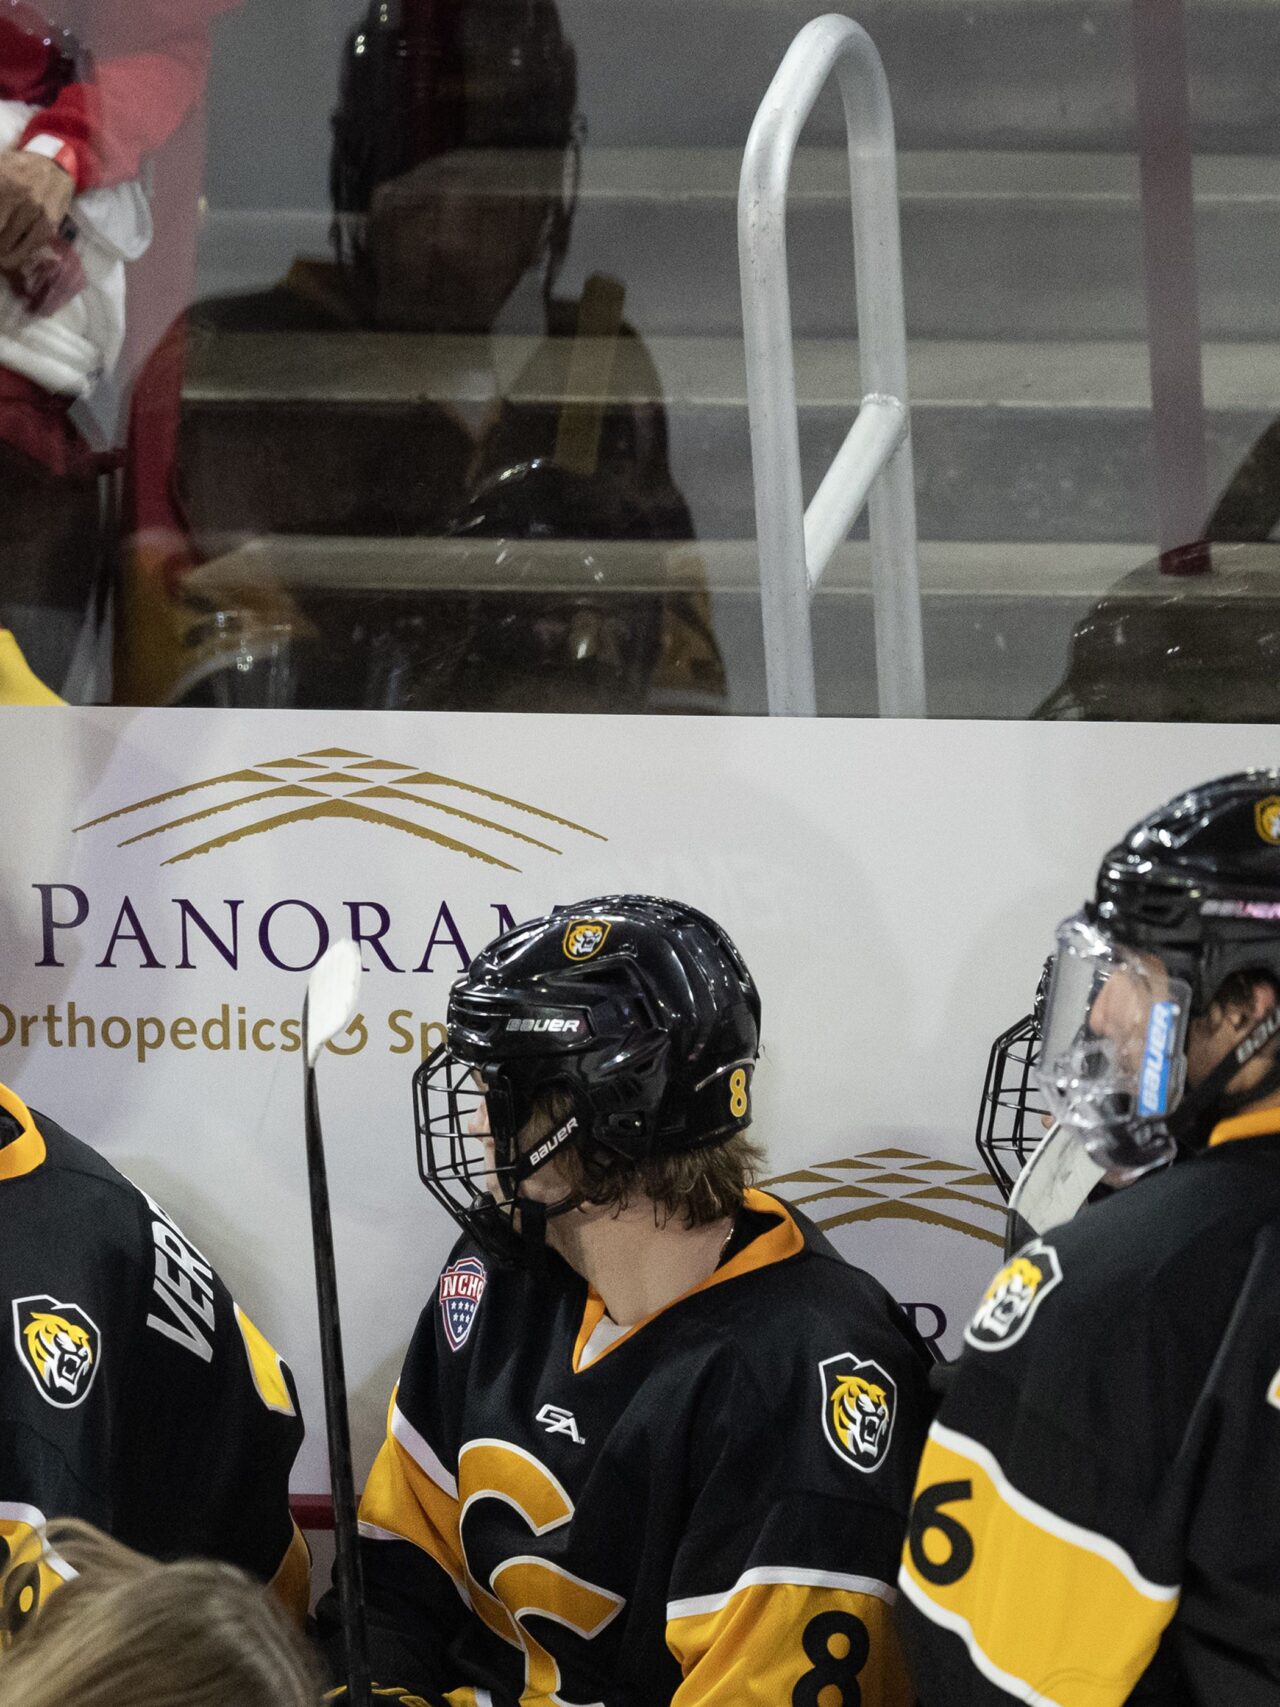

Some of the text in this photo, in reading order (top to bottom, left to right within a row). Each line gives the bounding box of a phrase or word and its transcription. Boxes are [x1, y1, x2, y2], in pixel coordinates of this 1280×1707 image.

[506, 1018, 581, 1033] BAUER
[729, 1068, 747, 1118] 8
[529, 1115, 579, 1167] BAUER
[791, 1610, 870, 1707] 8
